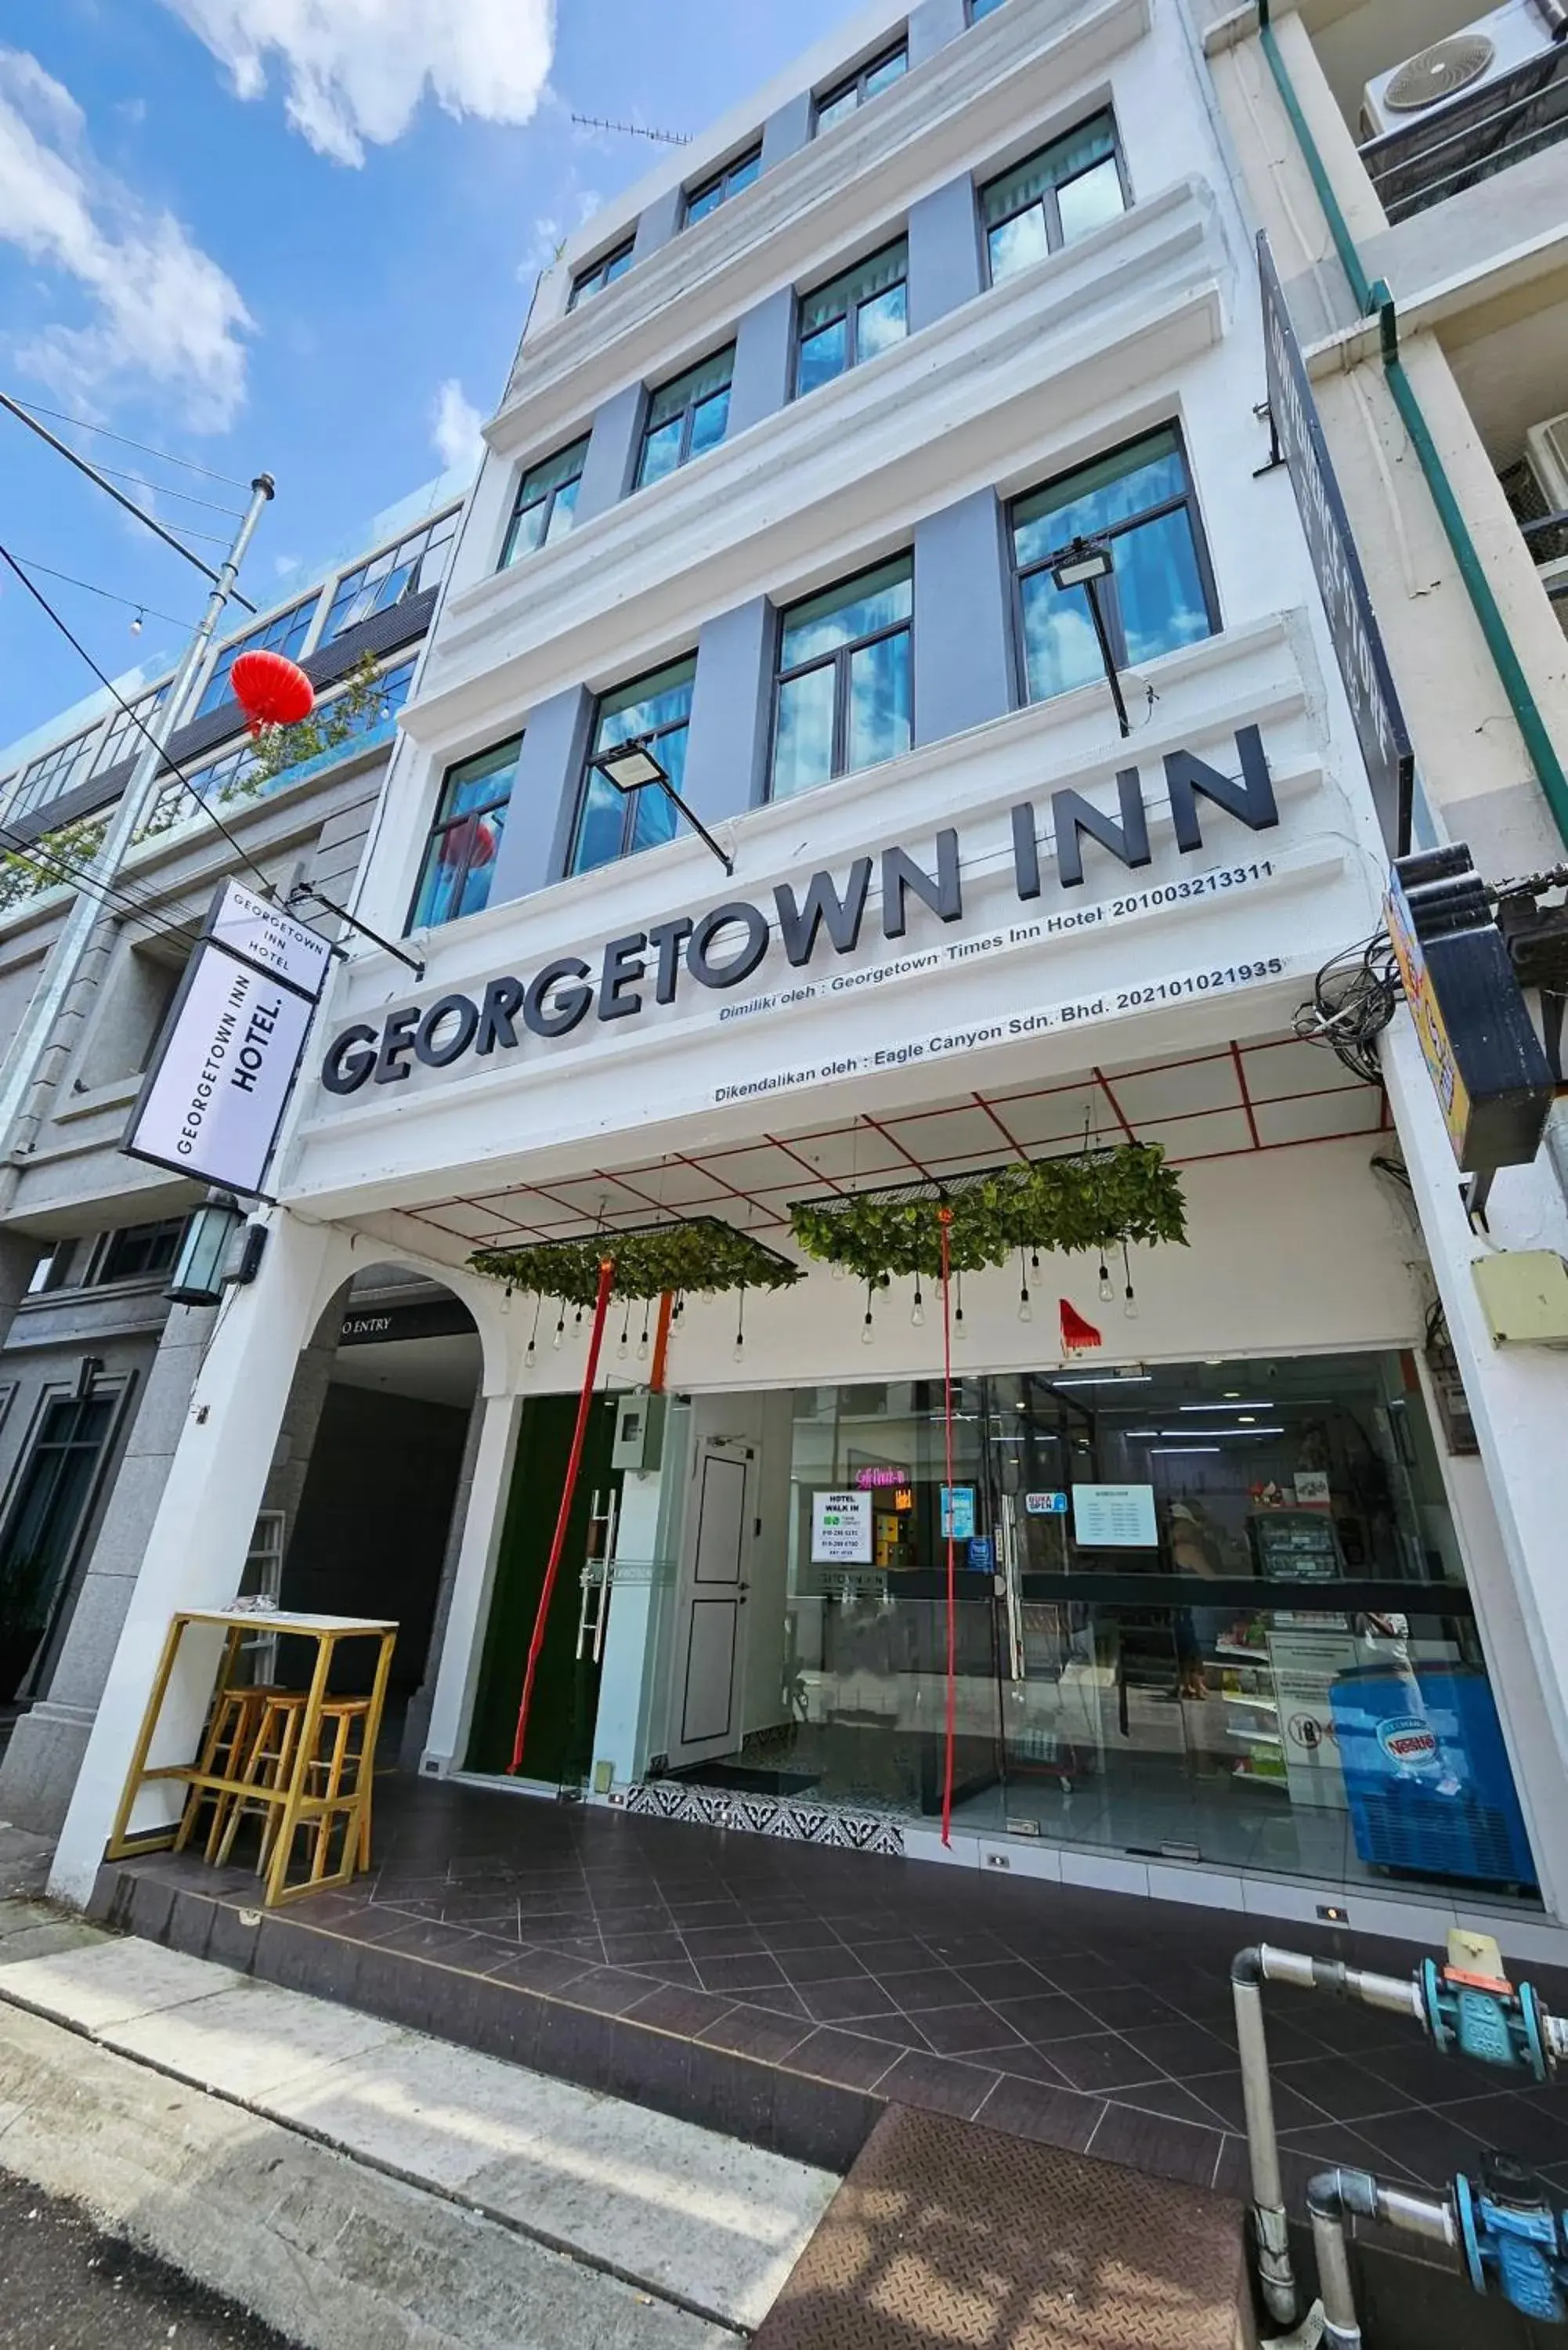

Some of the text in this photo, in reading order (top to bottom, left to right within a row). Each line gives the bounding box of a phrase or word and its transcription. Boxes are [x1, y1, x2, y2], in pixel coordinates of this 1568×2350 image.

[233, 893, 323, 956] GEORGETOWN
[249, 941, 290, 971] HOTEL
[263, 930, 287, 950] INN
[321, 724, 1279, 1095] GEORGETOWN INN
[719, 995, 775, 1020] Dimiliki
[781, 987, 815, 1004] oleh
[831, 955, 938, 990] Georgetown
[946, 935, 1003, 961] Times
[1009, 925, 1040, 943] Inn
[1047, 906, 1102, 932] Hotel
[1112, 861, 1274, 917] 201003213311
[177, 974, 251, 1156] GEORGETOWN INN
[714, 1068, 815, 1102] Dikendalikan
[821, 1057, 857, 1077] oleh
[874, 1044, 923, 1066] Eagle
[930, 1025, 1002, 1054] Canyon
[1009, 1015, 1053, 1034] Sdn.
[1061, 1000, 1109, 1022] Bhd.
[1116, 957, 1282, 1010] 202101021935
[353, 1318, 392, 1332] ENTRY
